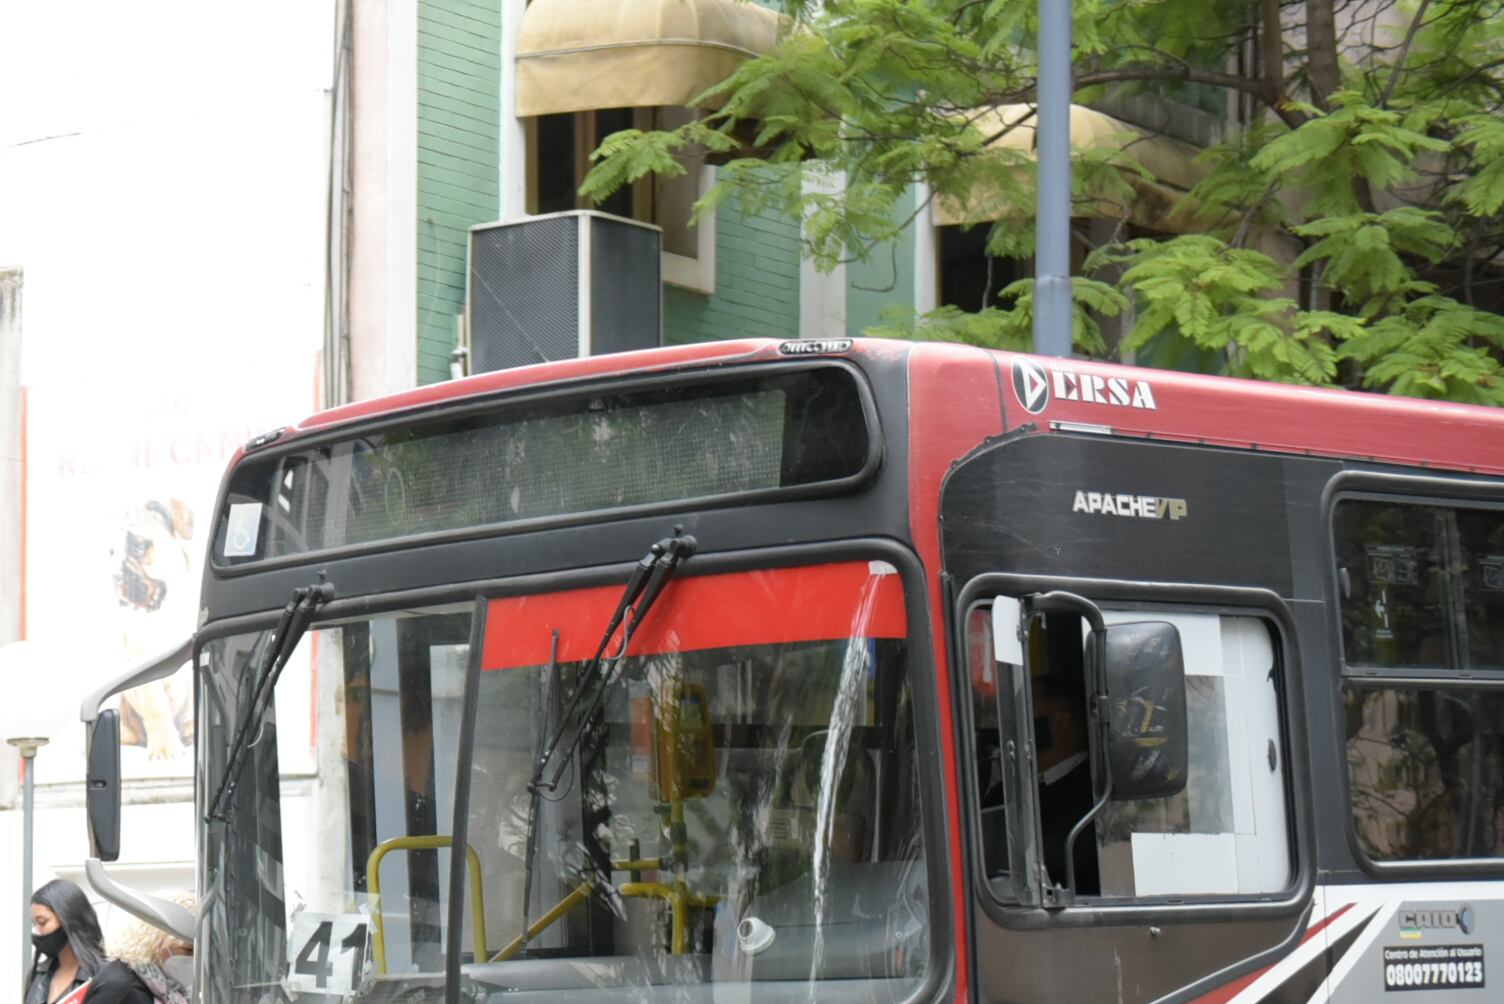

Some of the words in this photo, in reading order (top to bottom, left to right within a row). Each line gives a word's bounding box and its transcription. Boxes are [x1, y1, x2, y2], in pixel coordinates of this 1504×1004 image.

[1052, 370, 1157, 410] ERSA
[294, 921, 372, 990] 41
[1384, 950, 1408, 959] Centro
[1409, 949, 1418, 959] de
[1449, 948, 1456, 957] al
[1386, 961, 1483, 986] 08007770123
